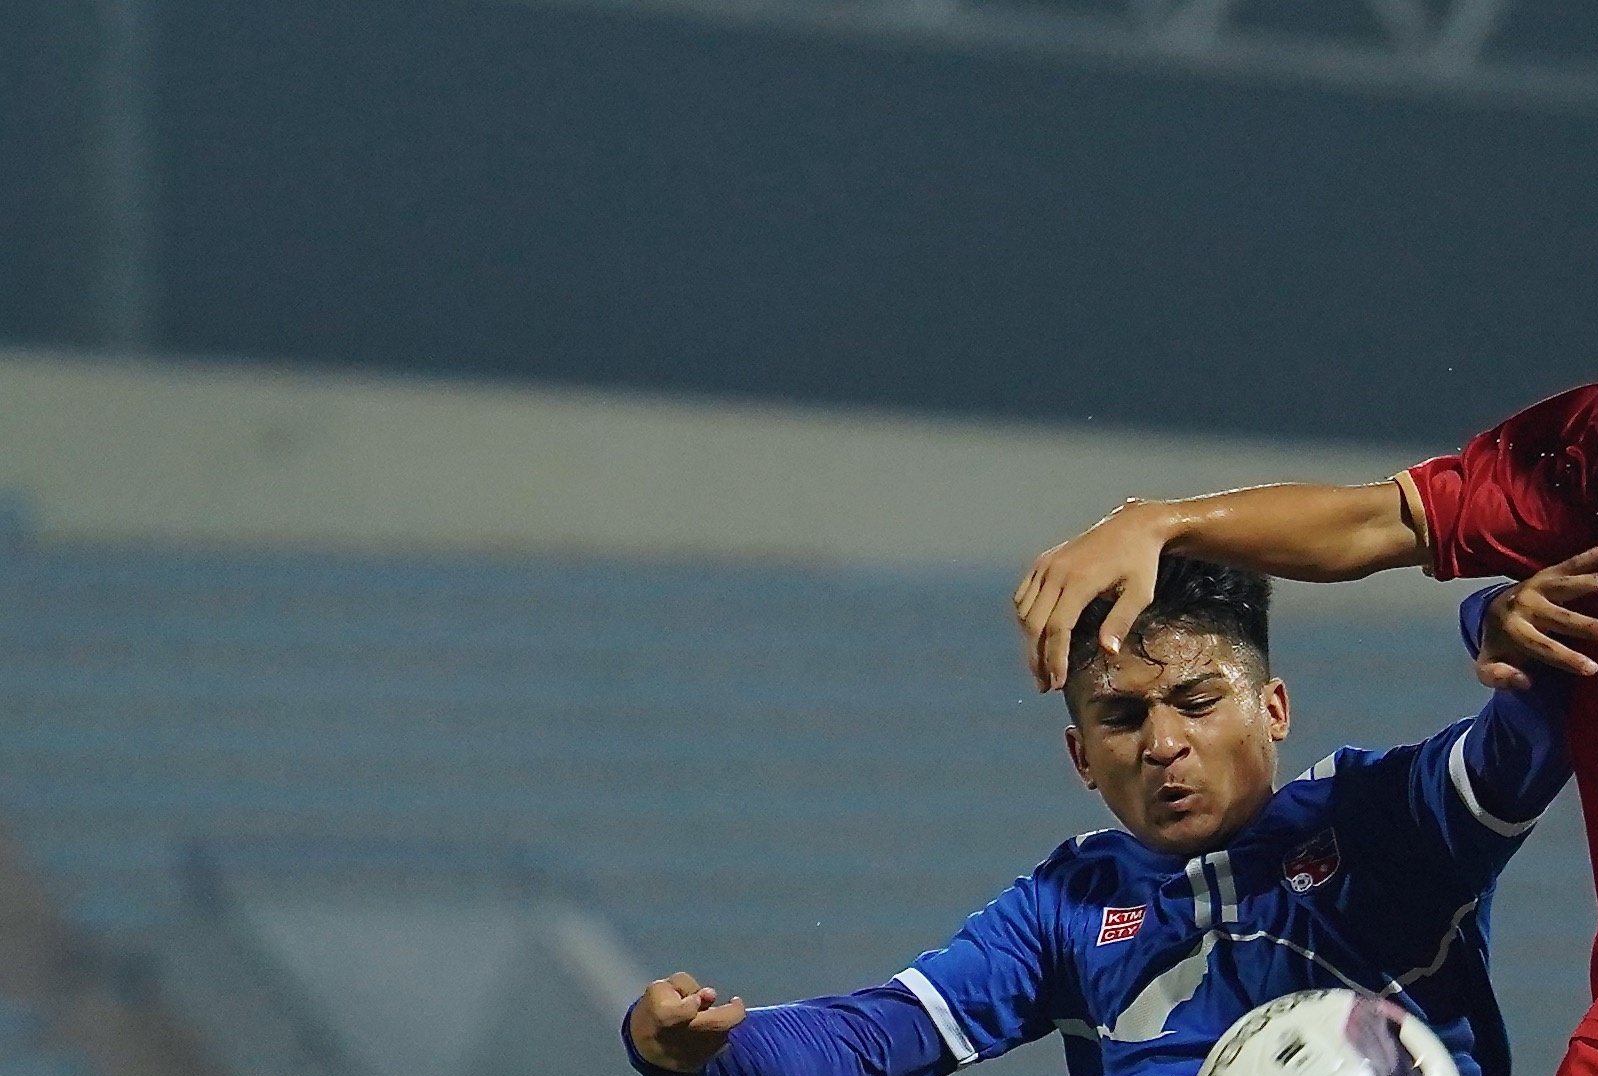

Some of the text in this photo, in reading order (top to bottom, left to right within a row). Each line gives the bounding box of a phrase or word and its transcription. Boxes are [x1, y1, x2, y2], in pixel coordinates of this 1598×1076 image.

[1185, 850, 1238, 928] 11
[1107, 909, 1144, 924] KTM
[1104, 925, 1138, 940] CTY
